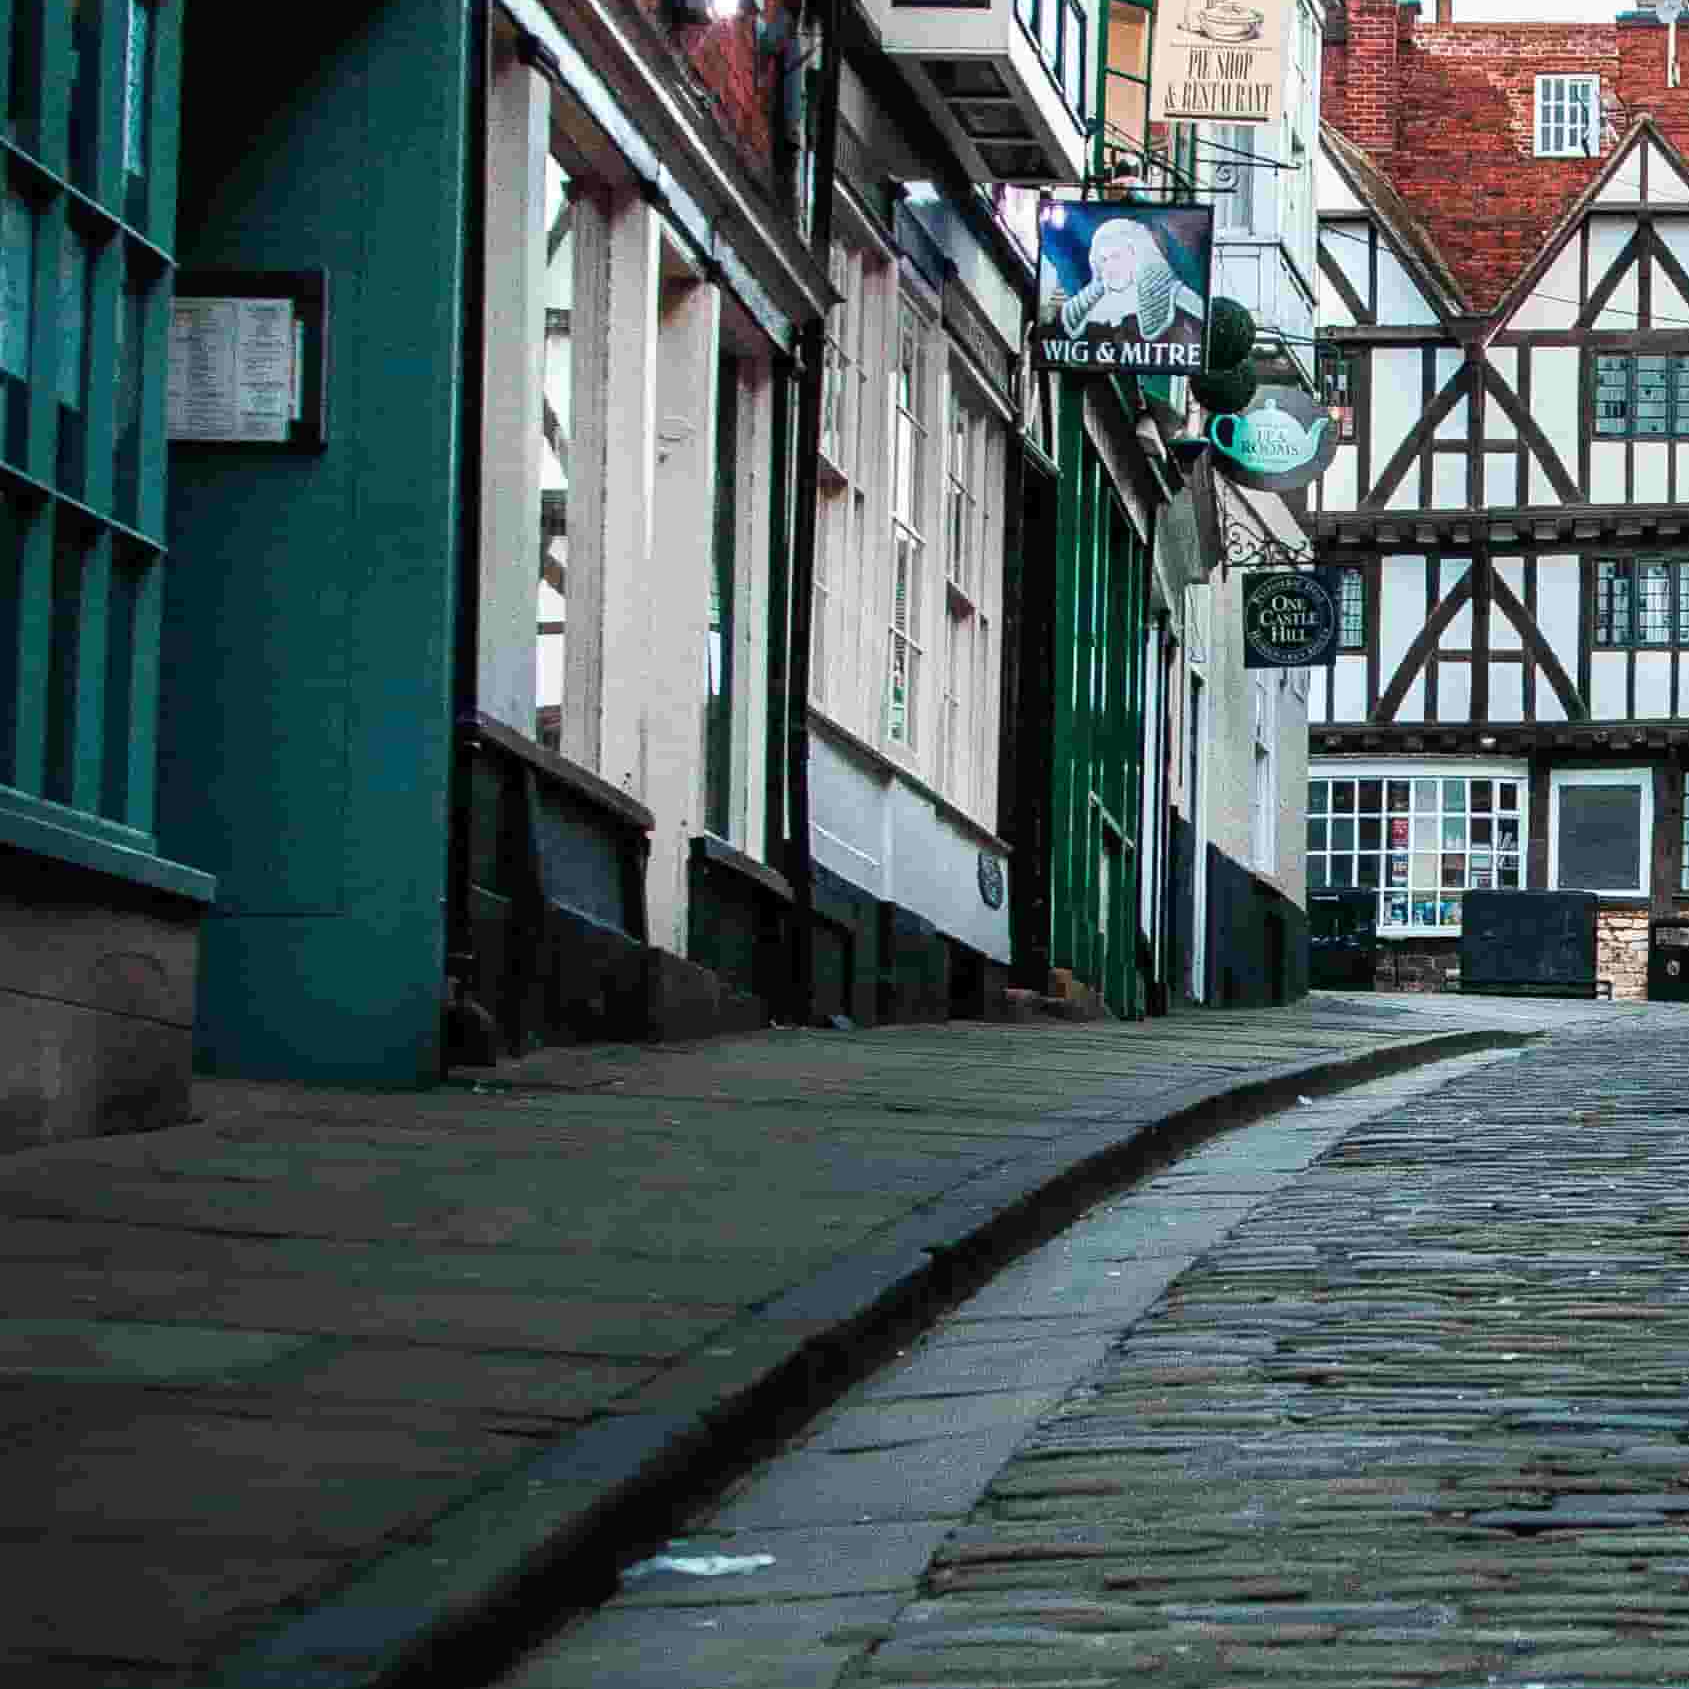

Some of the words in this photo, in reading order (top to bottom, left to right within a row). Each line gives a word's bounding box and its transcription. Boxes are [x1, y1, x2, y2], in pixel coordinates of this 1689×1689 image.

[1188, 49, 1210, 80] PIE
[1216, 50, 1254, 81] SHOP
[1181, 80, 1273, 113] RESTAURANT
[1041, 340, 1089, 364] WIG
[1095, 340, 1117, 364] &
[1120, 340, 1202, 366] MITRE
[1260, 609, 1321, 627] CASTLE
[1271, 625, 1312, 643] HILL
